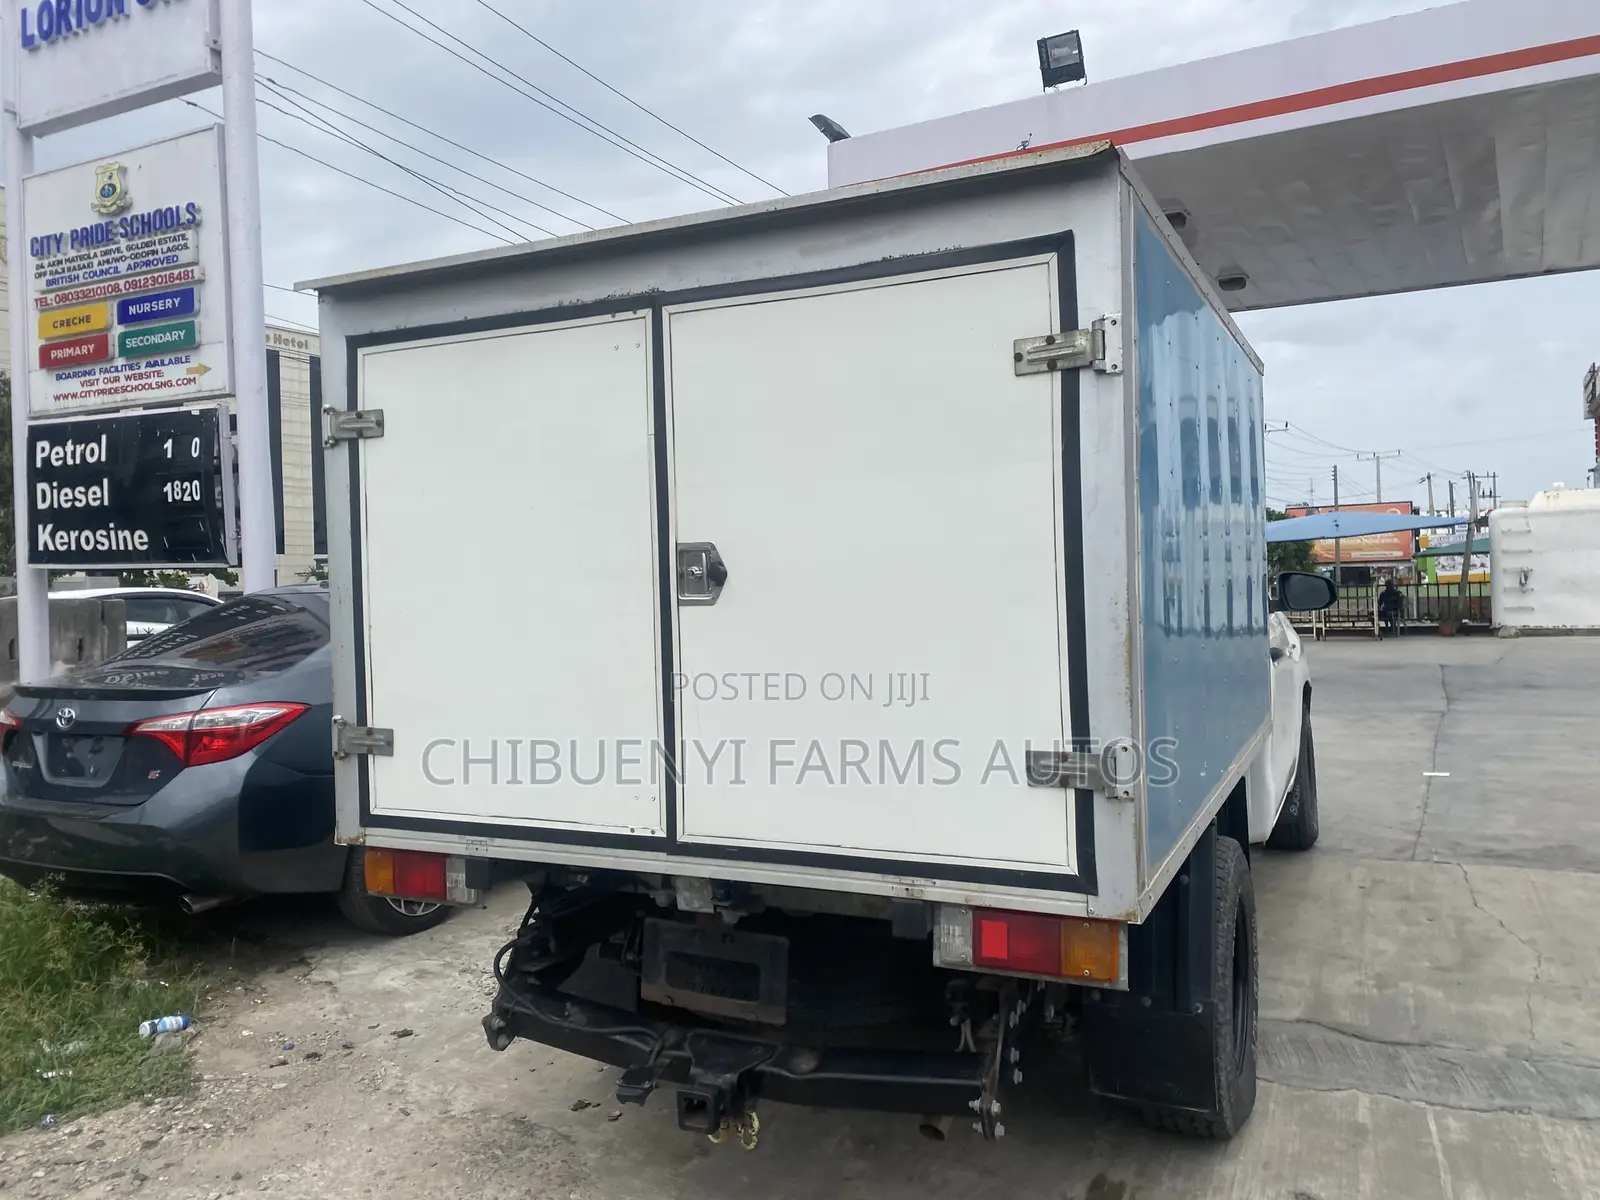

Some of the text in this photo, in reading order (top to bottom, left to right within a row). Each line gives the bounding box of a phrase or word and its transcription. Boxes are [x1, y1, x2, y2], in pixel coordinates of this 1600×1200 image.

[30, 202, 197, 257] CITY PRIDE SCHOOLS
[126, 241, 157, 252] GOLDEN
[34, 271, 48, 279] OFF
[46, 254, 179, 288] BRITISH COUNCIL APPROVED
[34, 296, 53, 309] TEL:
[124, 268, 195, 291] 09123016481
[52, 297, 181, 329] CRECHE NURSERY
[51, 330, 186, 360] PRIMARY SECONDARY
[273, 333, 308, 350] Hotel
[55, 355, 191, 381] BOARDING FACILITIES AVAILABLE
[80, 371, 164, 388] VISIT OUR WEBSITE:
[35, 434, 107, 468] Petrol
[36, 478, 201, 510] Diesel 1820
[37, 522, 149, 552] Kerosine
